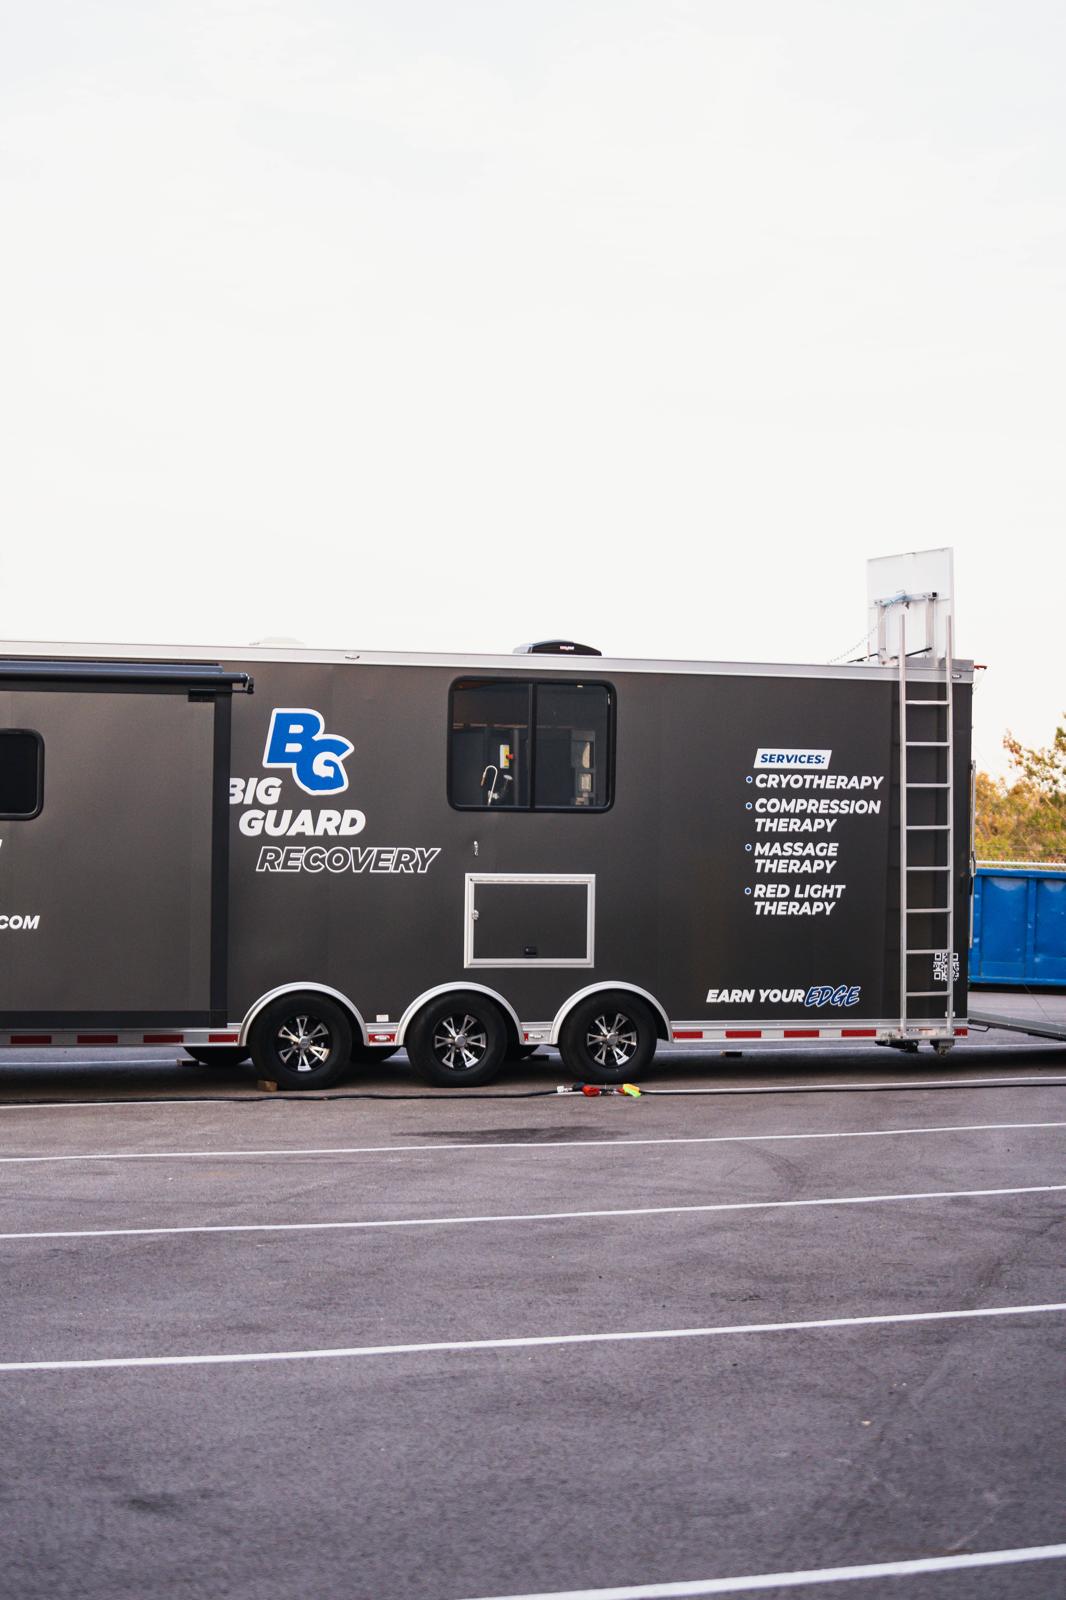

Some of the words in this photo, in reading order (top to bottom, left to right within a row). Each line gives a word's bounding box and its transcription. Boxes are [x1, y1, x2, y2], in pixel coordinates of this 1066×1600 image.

[262, 708, 355, 796] BG
[760, 753, 826, 765] SERVICES:
[755, 773, 884, 790] CRYOTHERAPY
[229, 777, 283, 805] BIG
[754, 798, 881, 815] COMPRESSION
[239, 809, 366, 837] GUARD
[754, 818, 837, 832] THERAPY
[754, 842, 839, 857] MASSAGE
[256, 846, 441, 873] RECOVERY
[754, 859, 837, 874] THERAPY
[753, 884, 790, 898] RED
[794, 884, 846, 899] LIGHT
[754, 901, 836, 916] THERAPY
[706, 989, 755, 1003] EARN
[759, 989, 805, 1003] YOUR
[804, 985, 861, 1007] EDGE
